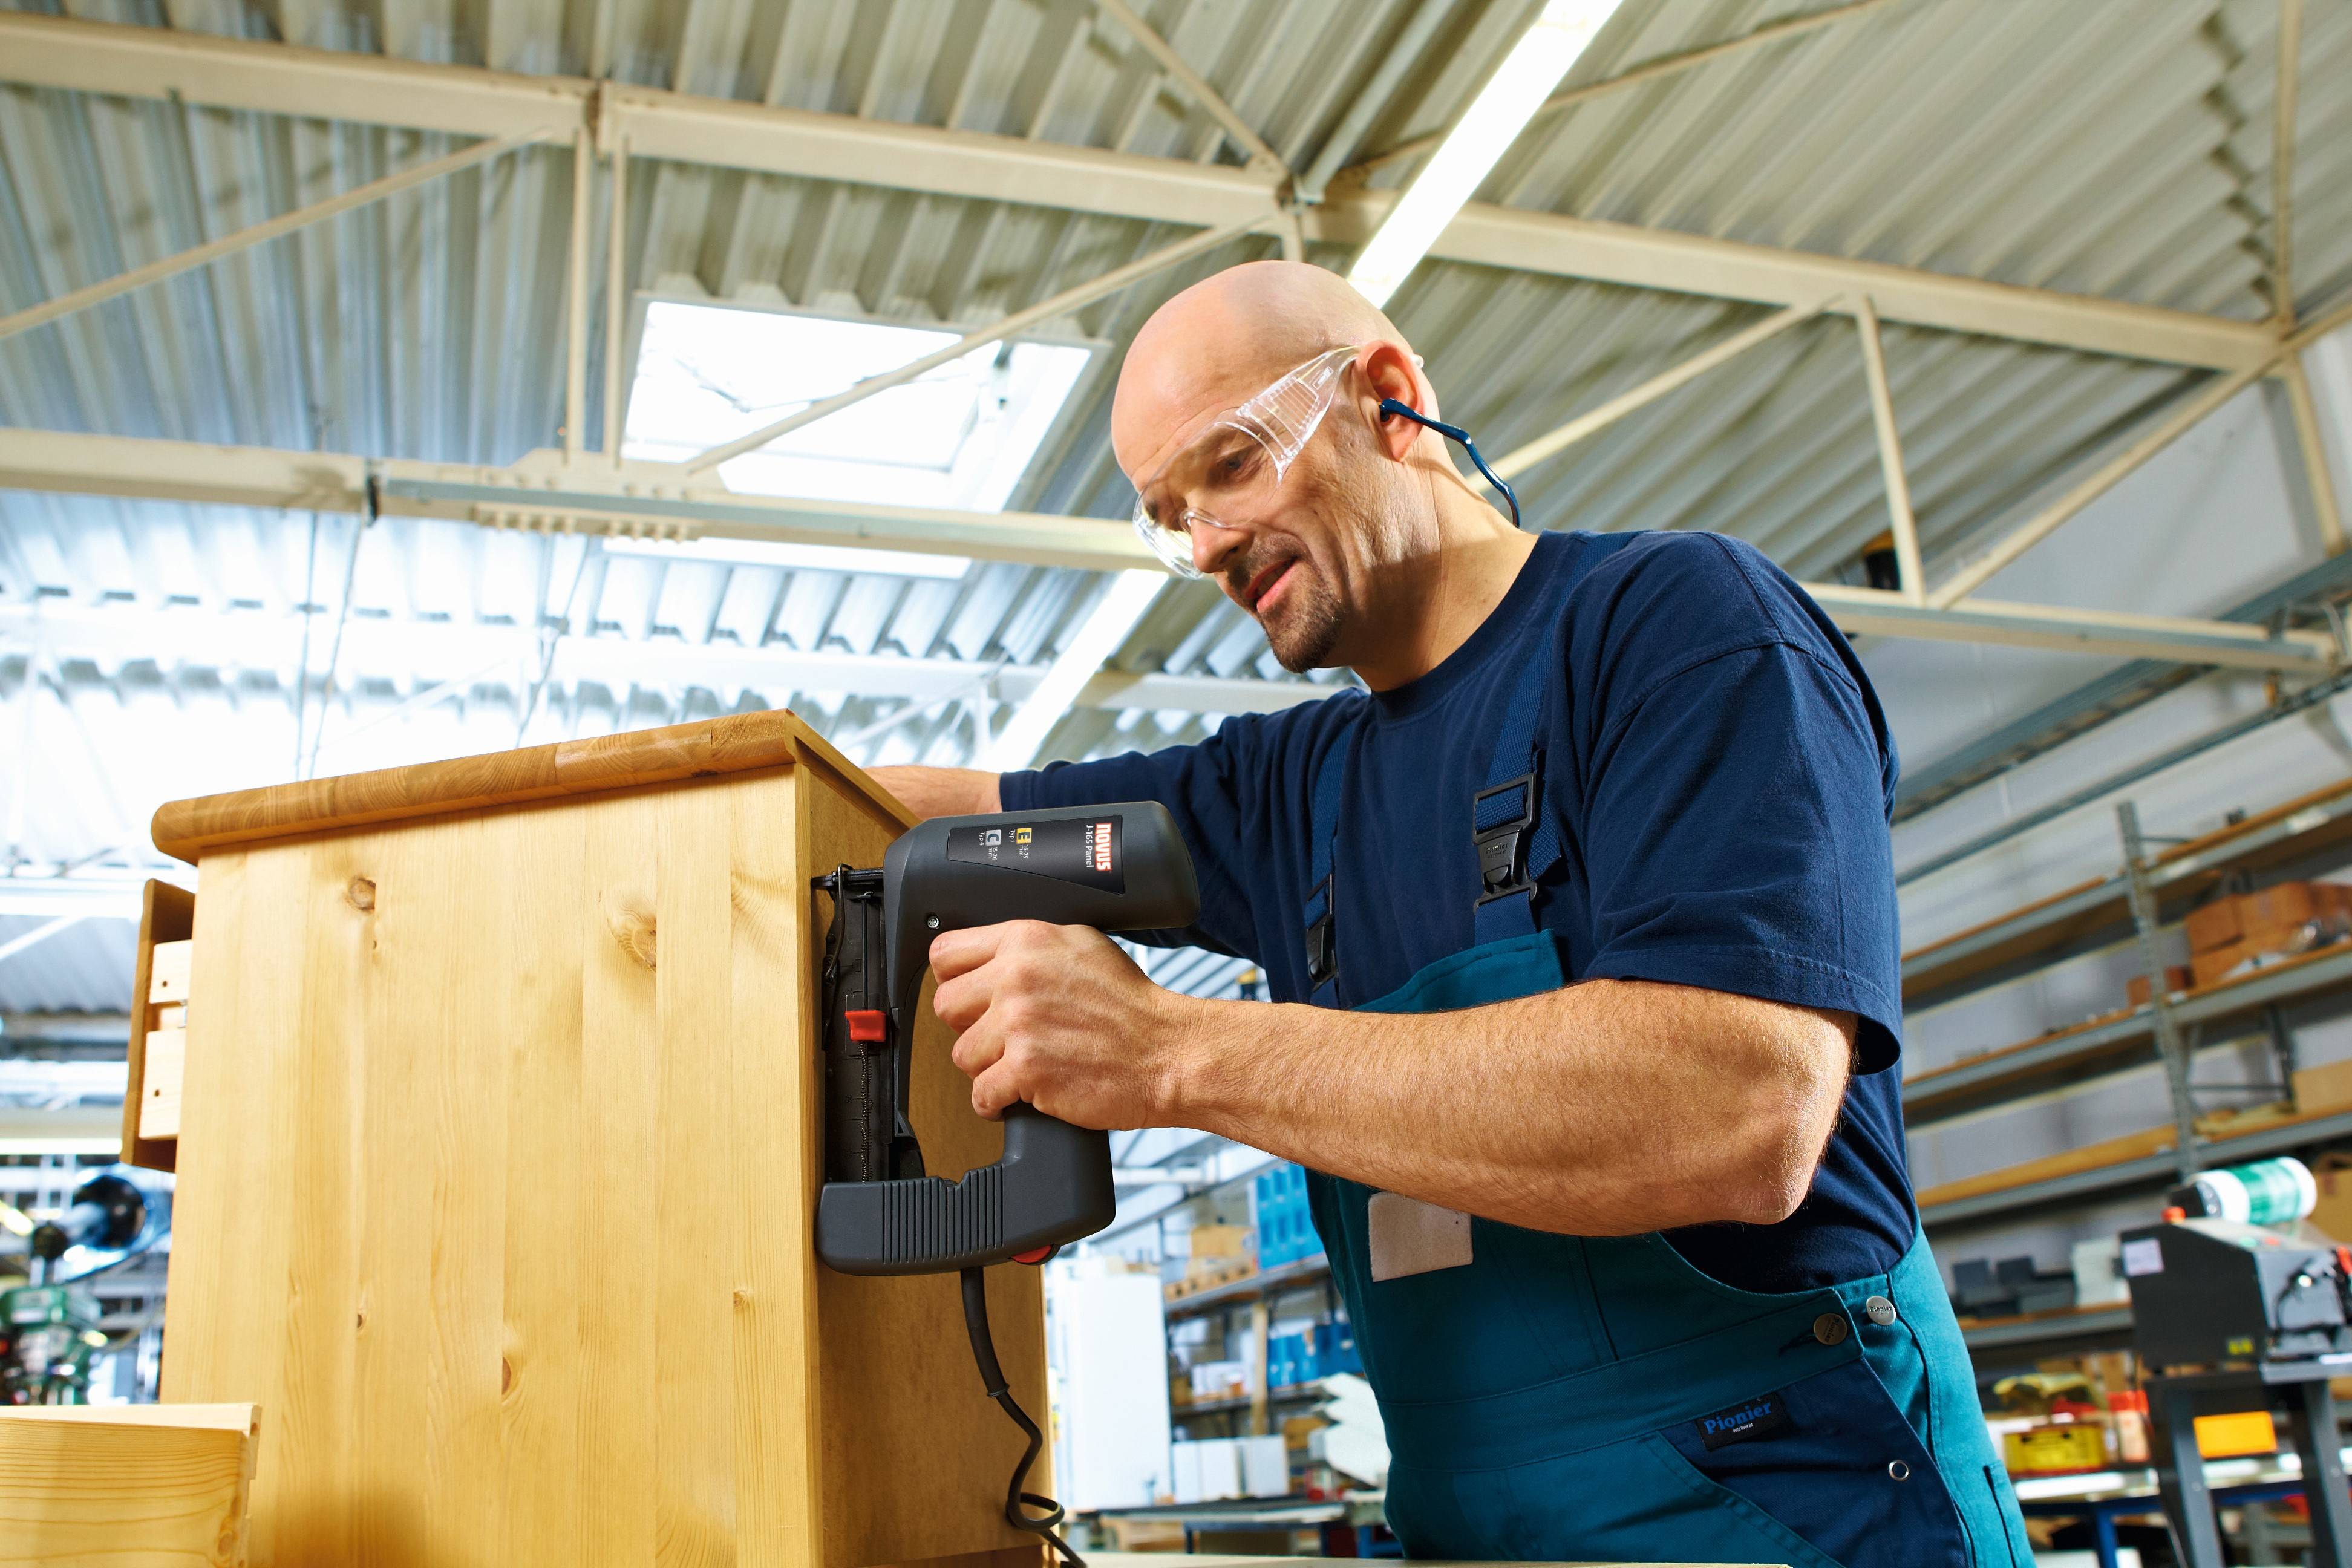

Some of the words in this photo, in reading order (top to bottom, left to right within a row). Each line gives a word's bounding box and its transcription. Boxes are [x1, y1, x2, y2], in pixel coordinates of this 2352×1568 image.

[987, 833, 999, 843] C
[988, 847, 993, 858] mm
[1019, 845, 1024, 856] mm
[1086, 846, 1094, 867] Panel
[1704, 1402, 1771, 1434] Pionier
